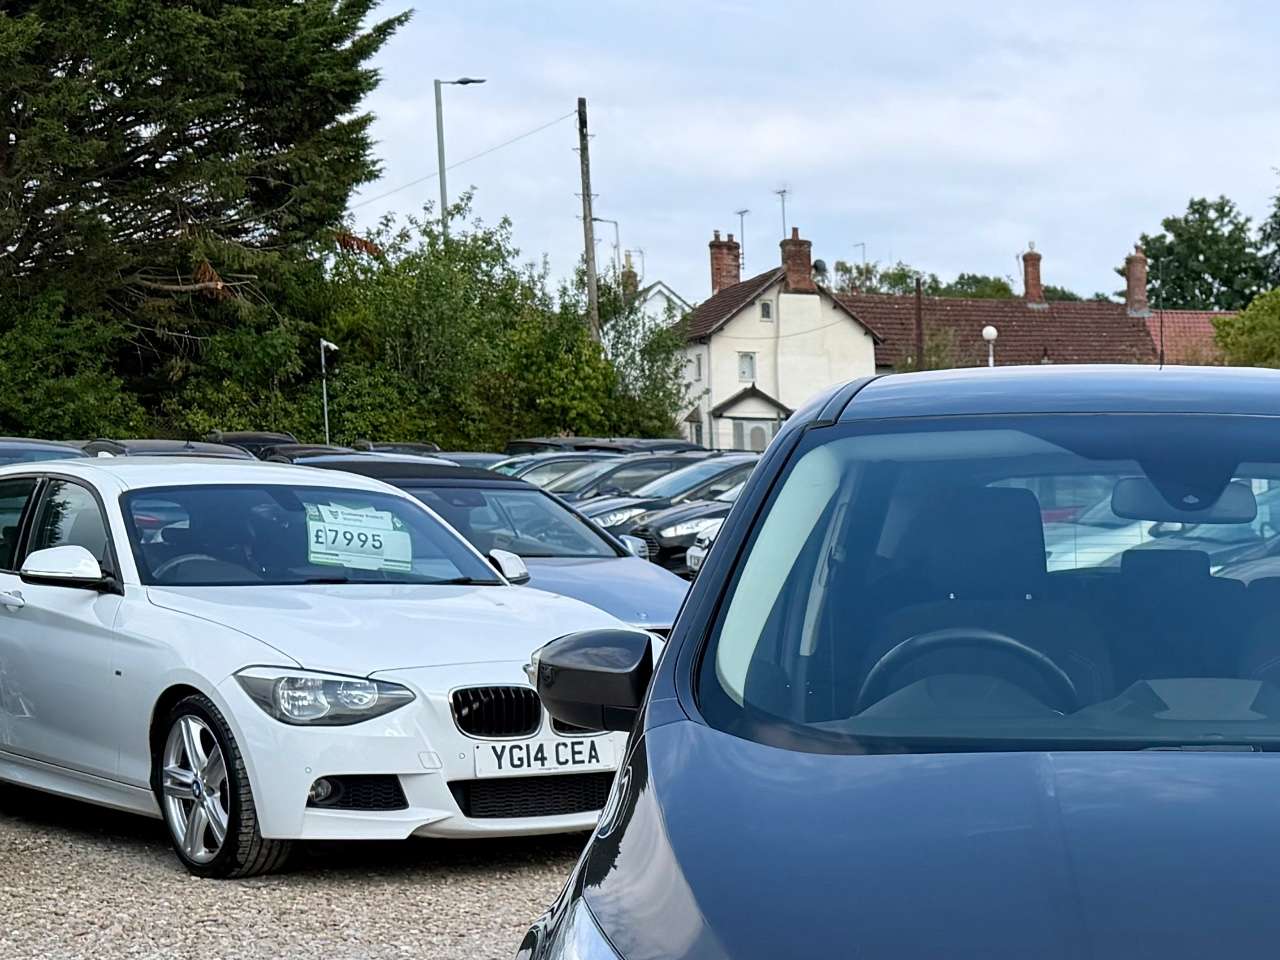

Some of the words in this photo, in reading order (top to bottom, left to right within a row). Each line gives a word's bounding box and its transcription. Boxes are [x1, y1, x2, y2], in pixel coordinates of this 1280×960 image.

[314, 528, 383, 550] £7995
[492, 744, 547, 770] YG14
[555, 741, 600, 765] CEA
